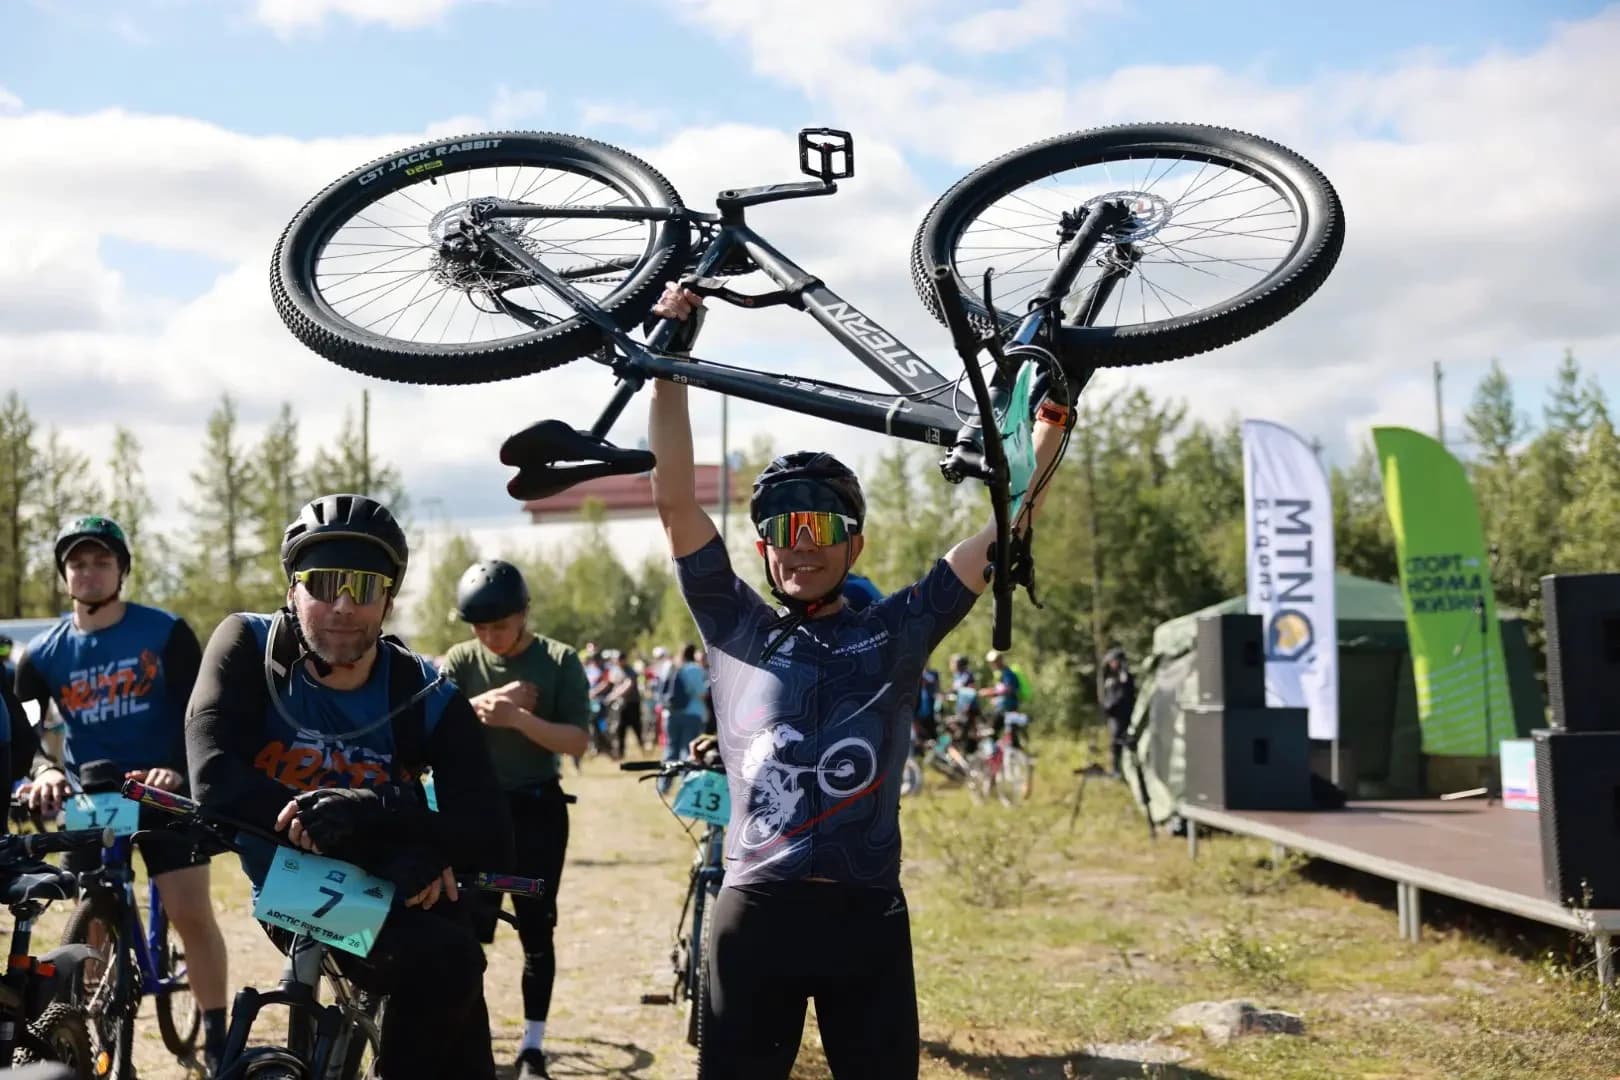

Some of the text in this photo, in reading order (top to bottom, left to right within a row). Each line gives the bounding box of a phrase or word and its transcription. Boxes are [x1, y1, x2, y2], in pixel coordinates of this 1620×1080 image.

[358, 166, 384, 186] CST
[388, 151, 431, 172] JACK
[435, 139, 502, 157] RABBIT
[823, 302, 933, 377] STERN
[690, 789, 720, 812] 13
[88, 807, 119, 828] 17
[311, 886, 345, 918] 7
[266, 909, 301, 926] ARCTIC
